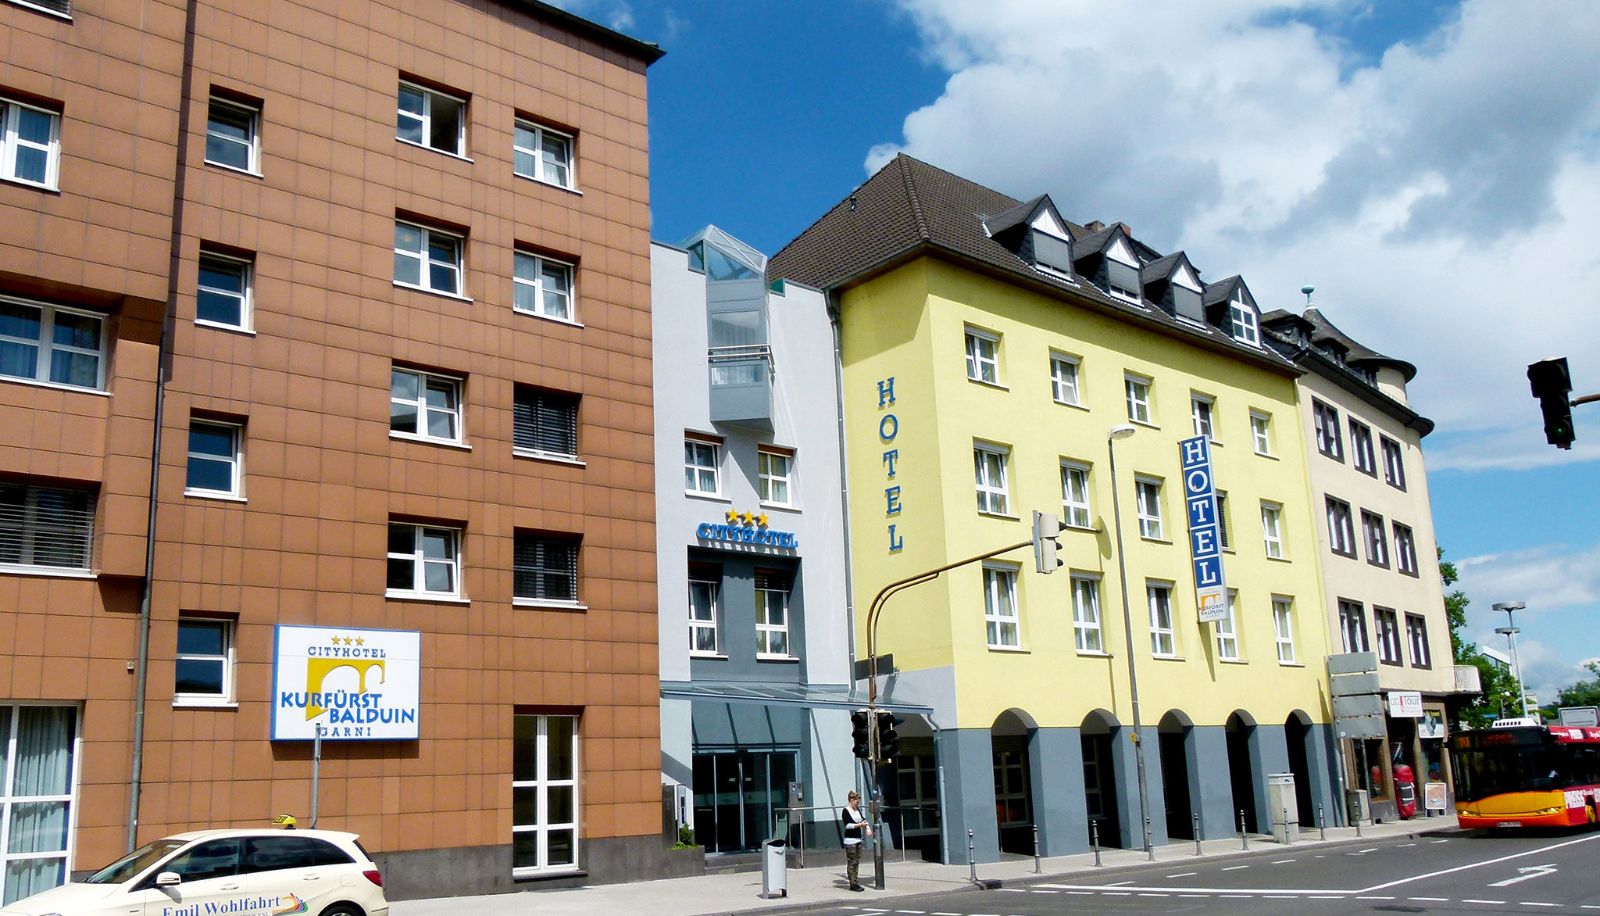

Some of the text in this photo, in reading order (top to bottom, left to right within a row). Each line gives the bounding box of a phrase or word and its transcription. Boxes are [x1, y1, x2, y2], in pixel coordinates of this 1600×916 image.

[877, 376, 903, 552] HOTEL
[1184, 439, 1217, 584] HOTEL
[697, 522, 799, 548] CITYHOTEL
[308, 646, 386, 658] CITYHOTEL
[281, 689, 382, 708] KURFÜRST
[329, 708, 415, 724] BALDUIN
[320, 727, 372, 737] GARNI
[163, 895, 281, 916] Emil Wohlfahrt
